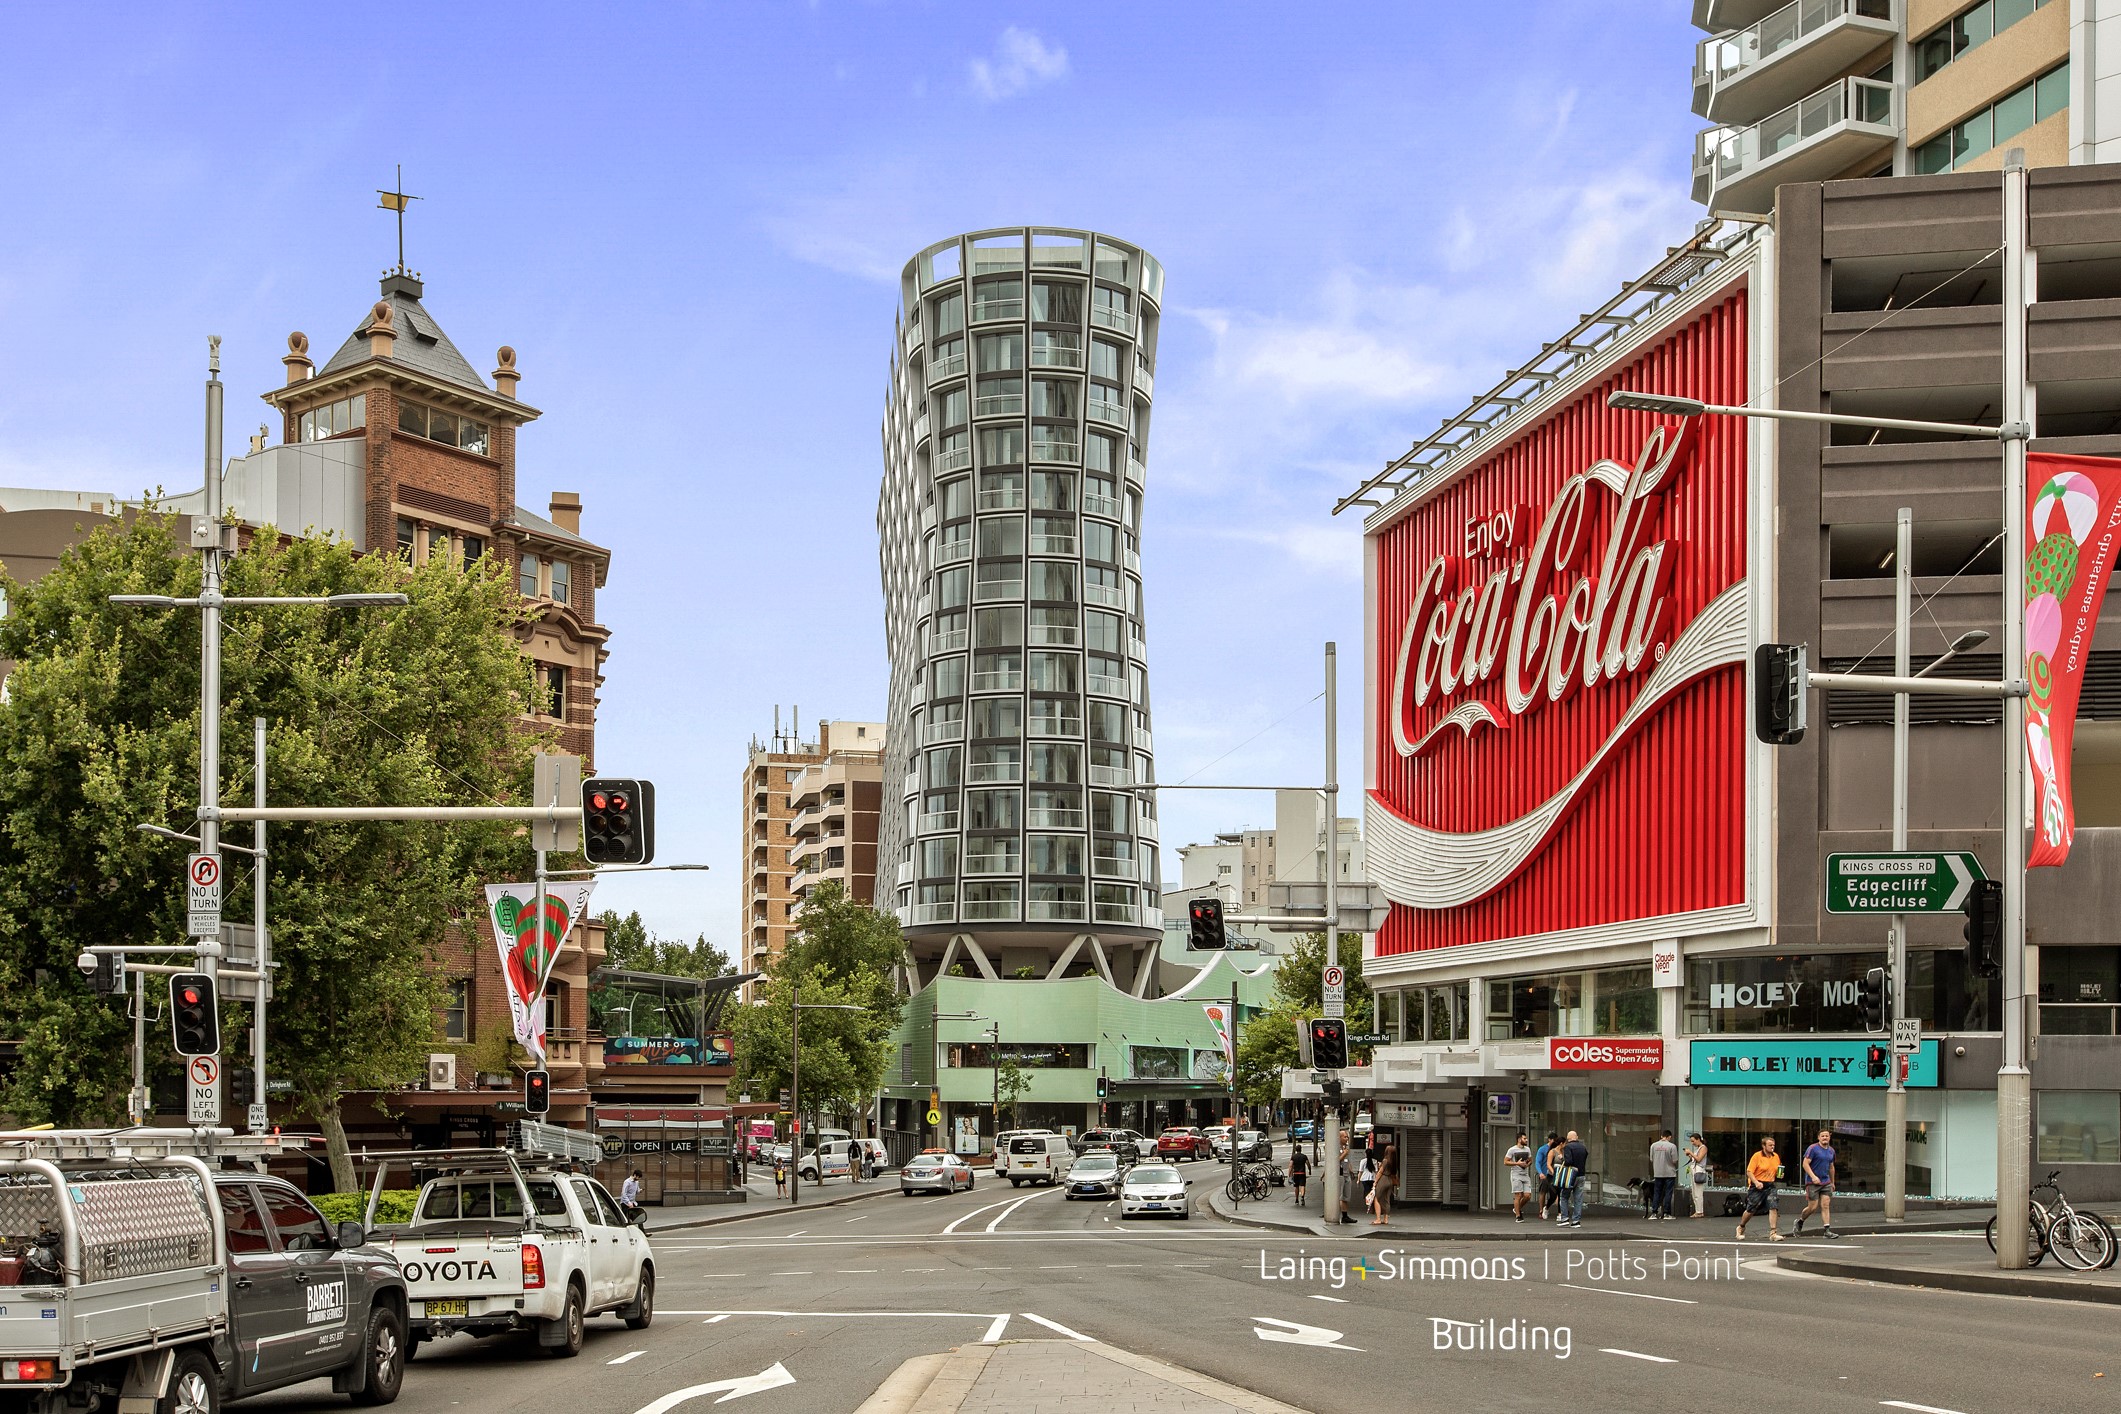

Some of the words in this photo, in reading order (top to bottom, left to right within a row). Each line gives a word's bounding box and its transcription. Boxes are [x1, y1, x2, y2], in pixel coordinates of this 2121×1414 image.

[1465, 510, 1517, 559] Enjoy
[1391, 415, 1698, 758] Coca-Cola
[1842, 863, 1874, 871] KINGS
[1878, 862, 1913, 871] CROSS
[1918, 862, 1933, 870] RD
[191, 886, 206, 897] NO
[211, 886, 219, 897] U
[1846, 878, 1927, 895] Edgecliff
[193, 899, 218, 908] TURN
[1846, 895, 1928, 908] Vaucluse
[1655, 951, 1675, 963] Claude
[1655, 961, 1670, 971] Neon
[1897, 1022, 1916, 1030] ONE
[1347, 1034, 1363, 1042] Kings
[1555, 1042, 1614, 1062] coles
[1615, 1046, 1659, 1055] Supermarket
[1615, 1055, 1636, 1064] Open
[1641, 1055, 1659, 1064] days
[1796, 1057, 1854, 1073] MOLEY
[195, 1089, 213, 1098] NO
[193, 1110, 216, 1119] TURN
[603, 1142, 623, 1151] VIP
[634, 1142, 660, 1151] OPEN
[671, 1142, 691, 1151] LATE
[400, 1260, 497, 1282] OYOTA
[306, 1281, 344, 1312] BARRETT
[306, 1309, 327, 1324] PLUMBING
[327, 1307, 344, 1320] SERVICES
